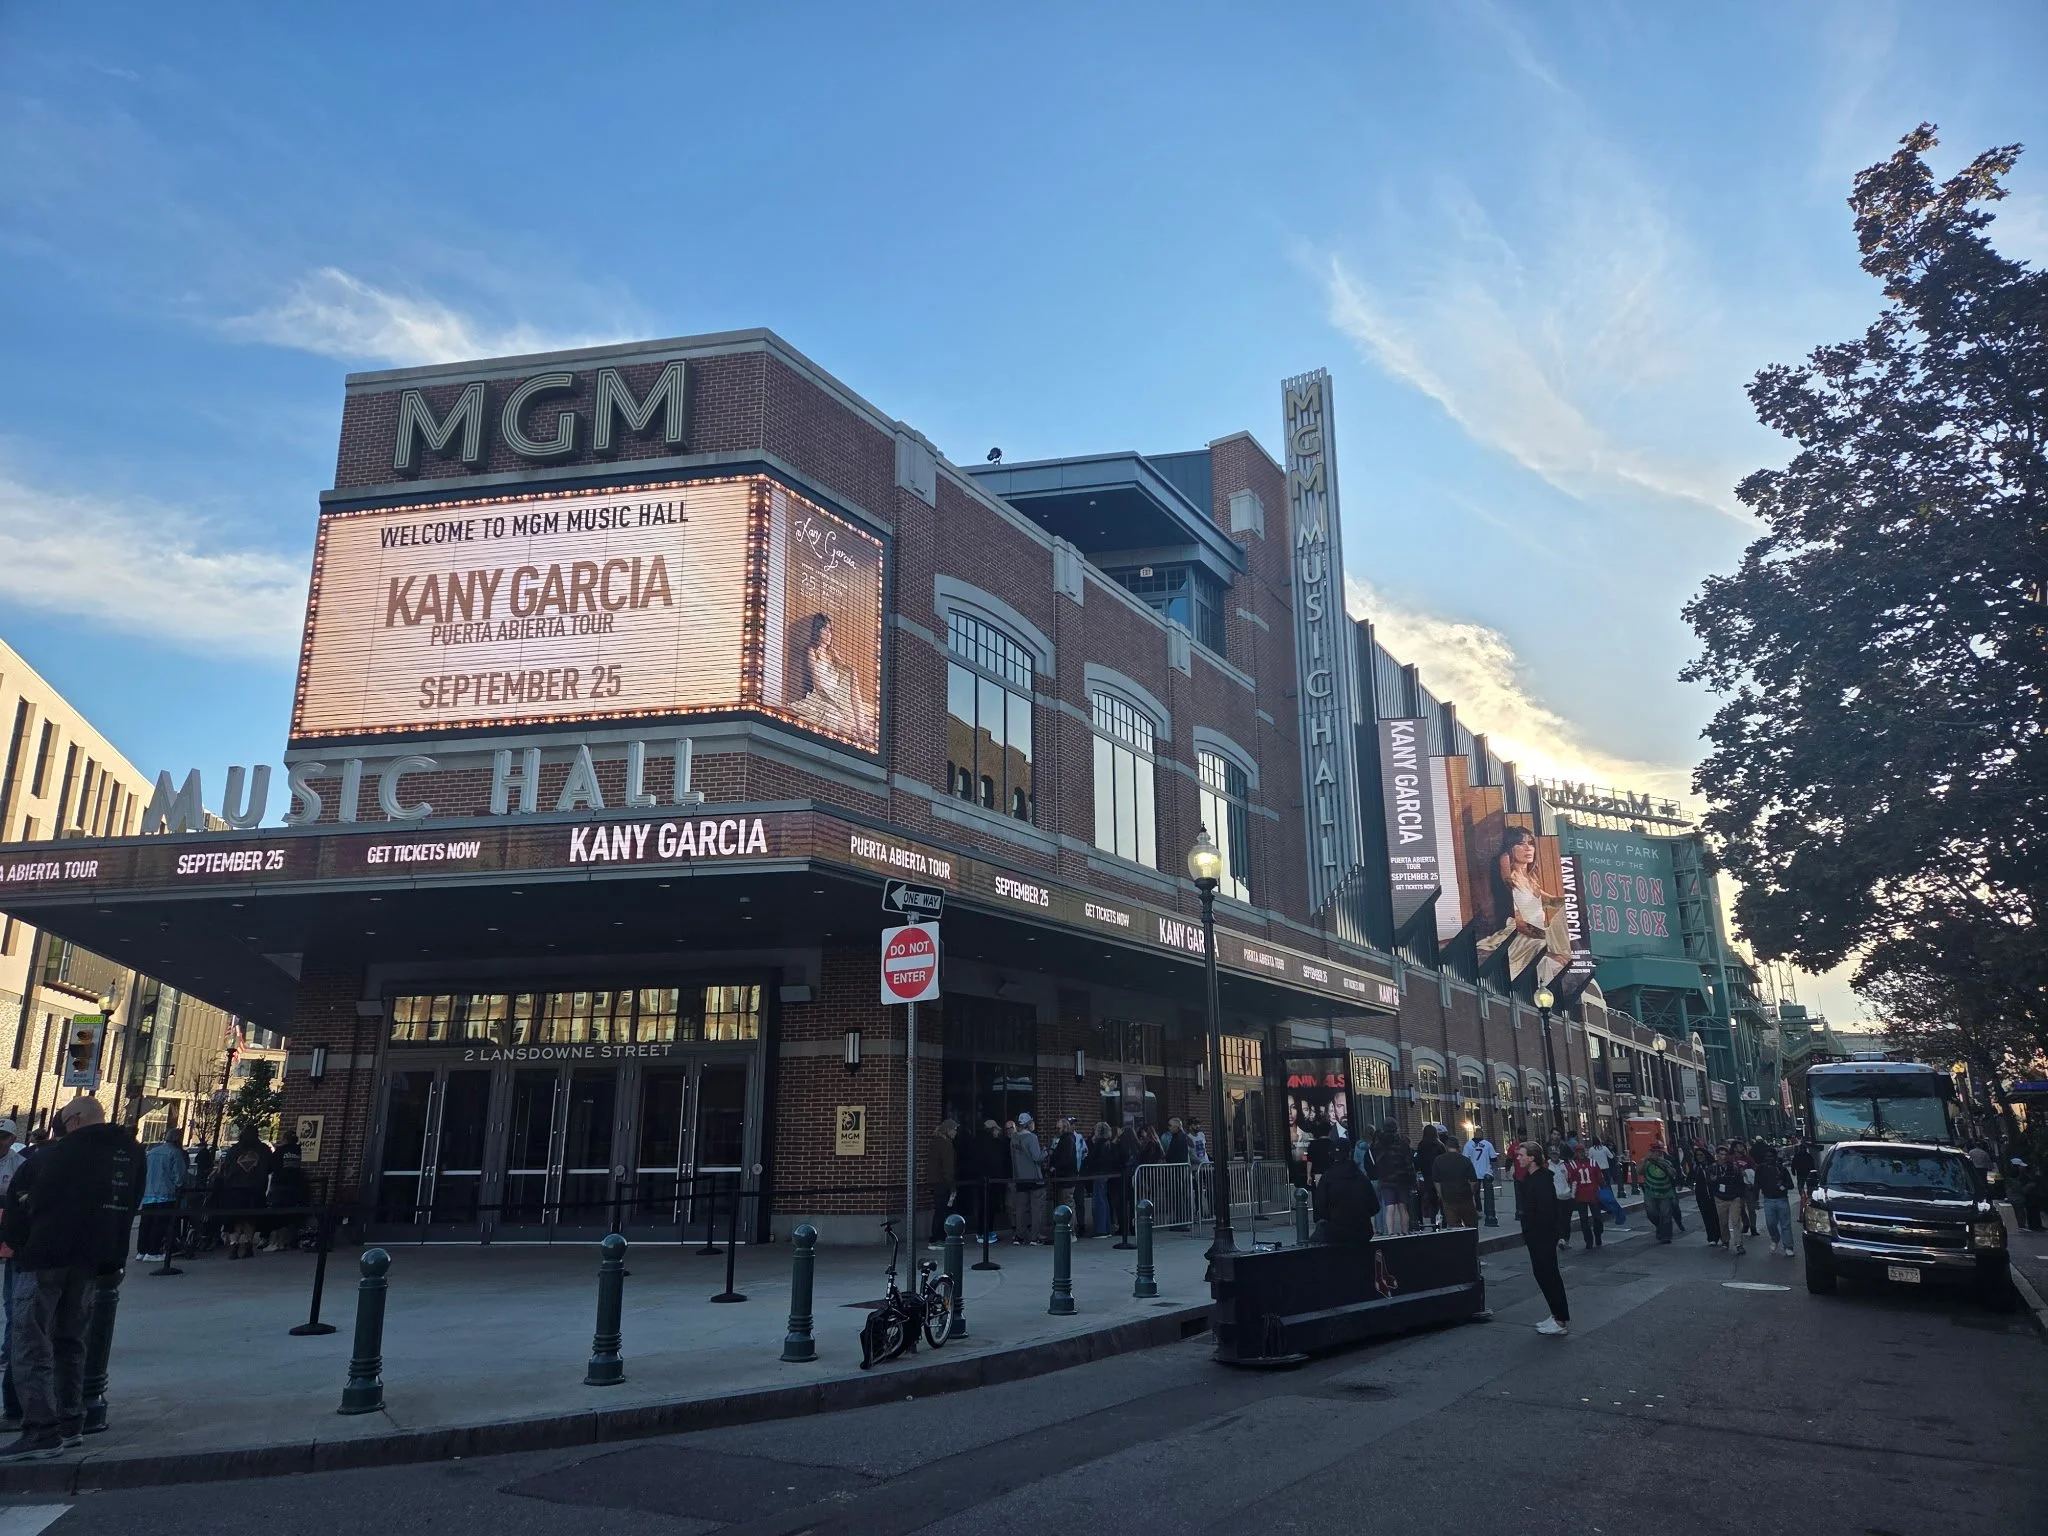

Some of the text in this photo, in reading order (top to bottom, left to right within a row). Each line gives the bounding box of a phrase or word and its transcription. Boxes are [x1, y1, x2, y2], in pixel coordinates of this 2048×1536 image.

[393, 359, 693, 477] MGM
[1286, 381, 1326, 500] MGM
[380, 501, 689, 548] WELCOME TO MGM MUSIC HALL
[385, 554, 673, 628] KANY GARCIA
[1297, 520, 1331, 698] MUSIC
[430, 612, 614, 647] PUERTA ABIERTA TOUR
[418, 664, 622, 710] SEPTEMBER 25
[141, 753, 437, 834] MUSIC
[489, 737, 705, 815] HALL
[1311, 715, 1337, 867] HALL
[1390, 720, 1424, 845] KANY GARCIA
[367, 841, 481, 864] GET TICKETS NOW
[569, 818, 769, 863] KANY GARCIA
[850, 835, 951, 880] PUERTA ABIERTA TOUR
[1567, 837, 1660, 860] FENWAY PARK
[6, 862, 60, 881] ABIERTA
[64, 860, 99, 879] TOUR
[176, 849, 285, 875] SEPTEMBER 25
[1391, 872, 1438, 881] SEPTEMBER 25
[1560, 856, 1577, 896] KANY
[1589, 857, 1644, 870] HOME OF THE
[903, 892, 939, 908] ONE WAY
[995, 876, 1049, 907] SEPTEMBER 25
[1583, 870, 1665, 906] OSTON
[1085, 902, 1130, 928] GET TICKETS NOW
[1564, 896, 1582, 941] GARCIA
[1626, 908, 1669, 937] SOX
[890, 941, 930, 957] DO NOT
[1159, 917, 1220, 958] KANY GARA
[893, 970, 926, 985] ENTER
[1378, 983, 1393, 1005] KANY
[464, 1044, 673, 1061] 2 LANSDOWNE STREET
[1475, 1148, 1483, 1161] 7
[1578, 1167, 1592, 1184] 11
